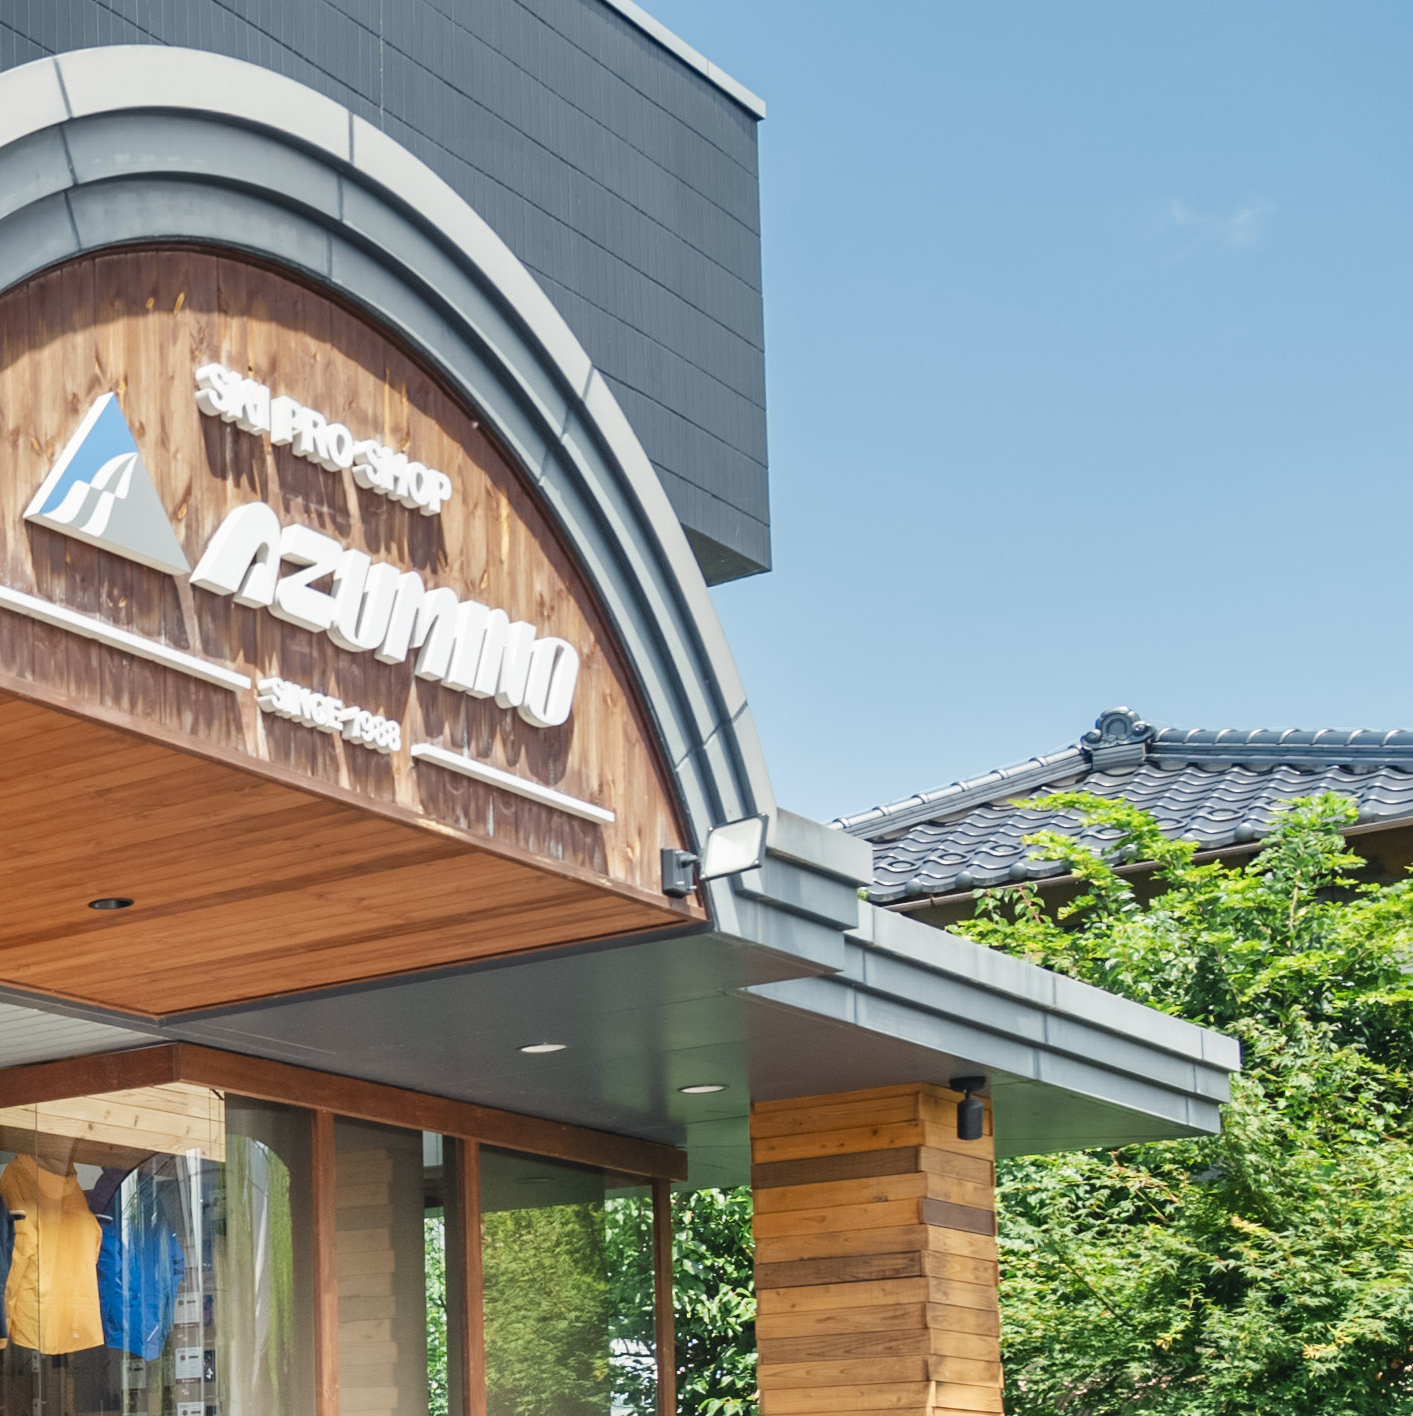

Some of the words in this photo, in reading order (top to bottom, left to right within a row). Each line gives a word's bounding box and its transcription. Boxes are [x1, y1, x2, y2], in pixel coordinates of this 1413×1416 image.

[195, 363, 271, 436] SKI
[270, 395, 354, 472] PRO
[351, 439, 452, 517] SHOP
[189, 501, 580, 729] AZUMINO
[257, 677, 344, 734] SINCE
[339, 706, 402, 754] 1988
